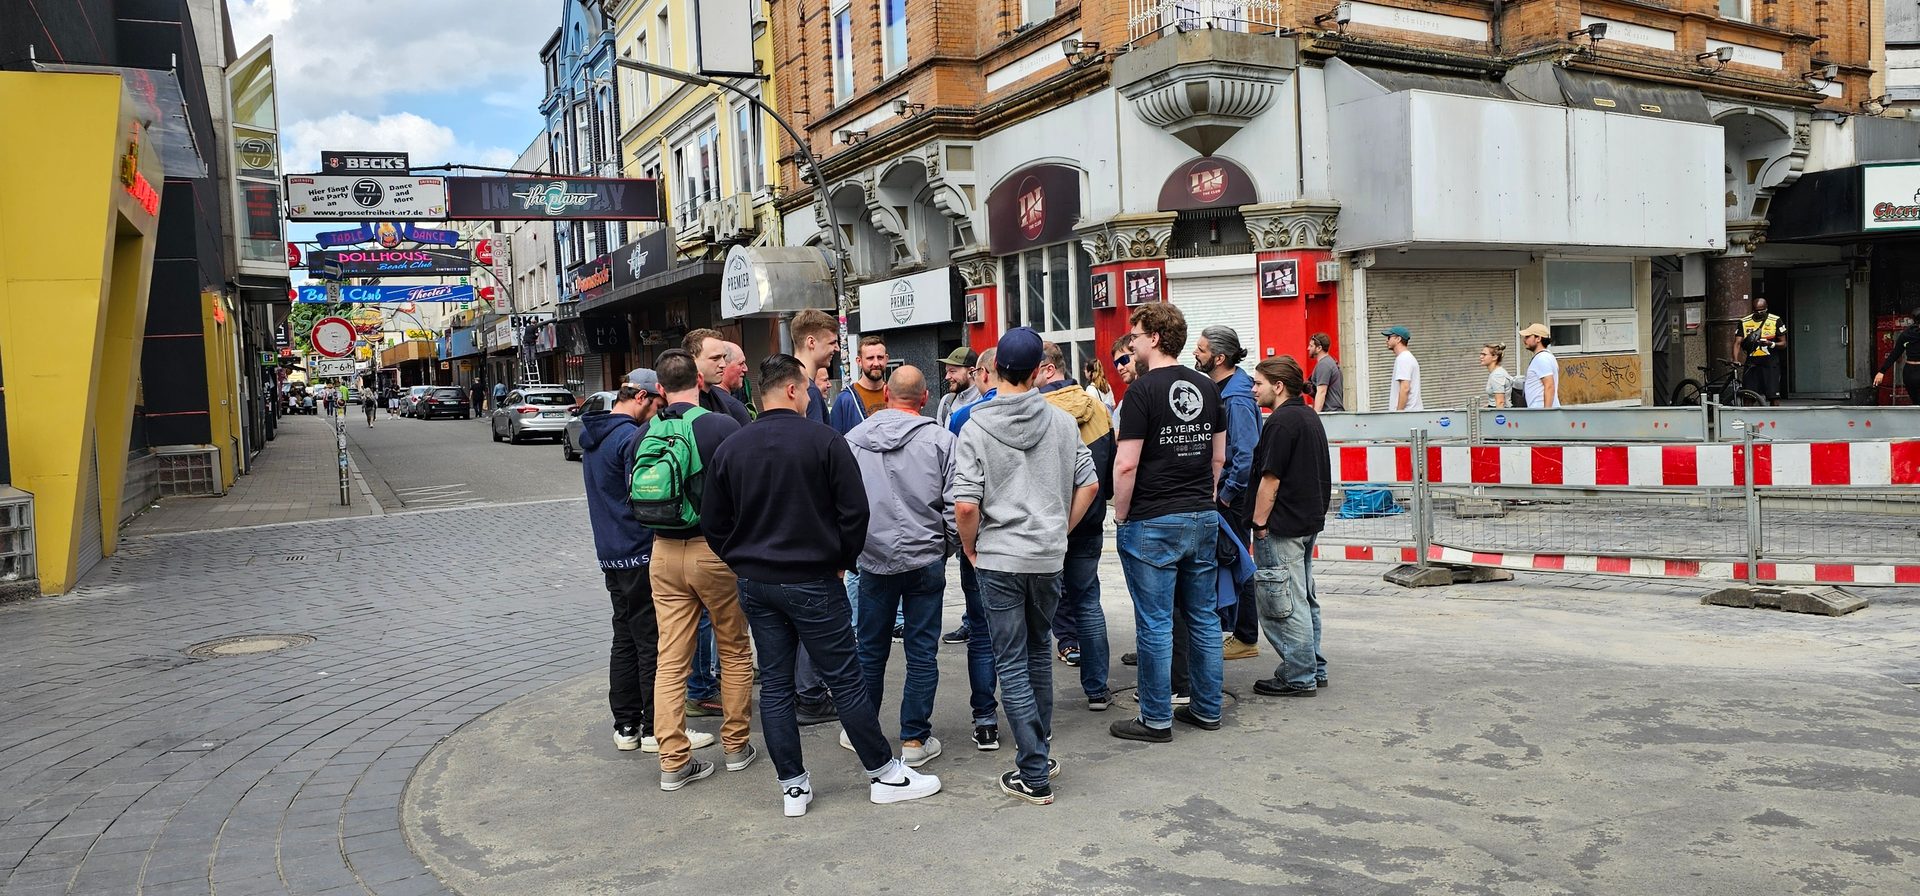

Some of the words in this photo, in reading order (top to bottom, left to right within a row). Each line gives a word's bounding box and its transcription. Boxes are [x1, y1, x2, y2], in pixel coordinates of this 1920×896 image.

[346, 157, 405, 169] BECK'S
[389, 183, 413, 191] Dance
[1190, 168, 1224, 194] IN
[327, 185, 349, 195] fängt
[327, 192, 349, 200] Party
[481, 183, 509, 210] IN
[523, 184, 546, 209] the
[545, 181, 587, 216] plane
[1019, 186, 1043, 227] IN
[1873, 202, 1920, 218] Cherr
[331, 231, 365, 243] TABLE
[413, 229, 445, 242] DANCE
[339, 251, 433, 263] DOLLHOUSE
[377, 261, 408, 271] Beach
[410, 261, 433, 269] Club
[728, 272, 750, 291] PREMIER
[1265, 267, 1293, 289] IN
[1093, 280, 1107, 301] IN
[1129, 276, 1156, 296] IN
[349, 288, 382, 301] Club
[890, 294, 914, 309] PREMIER
[967, 300, 977, 317] IN
[1160, 426, 1172, 435] 25
[1203, 422, 1211, 431] O
[1159, 433, 1212, 445] EXCELLENC
